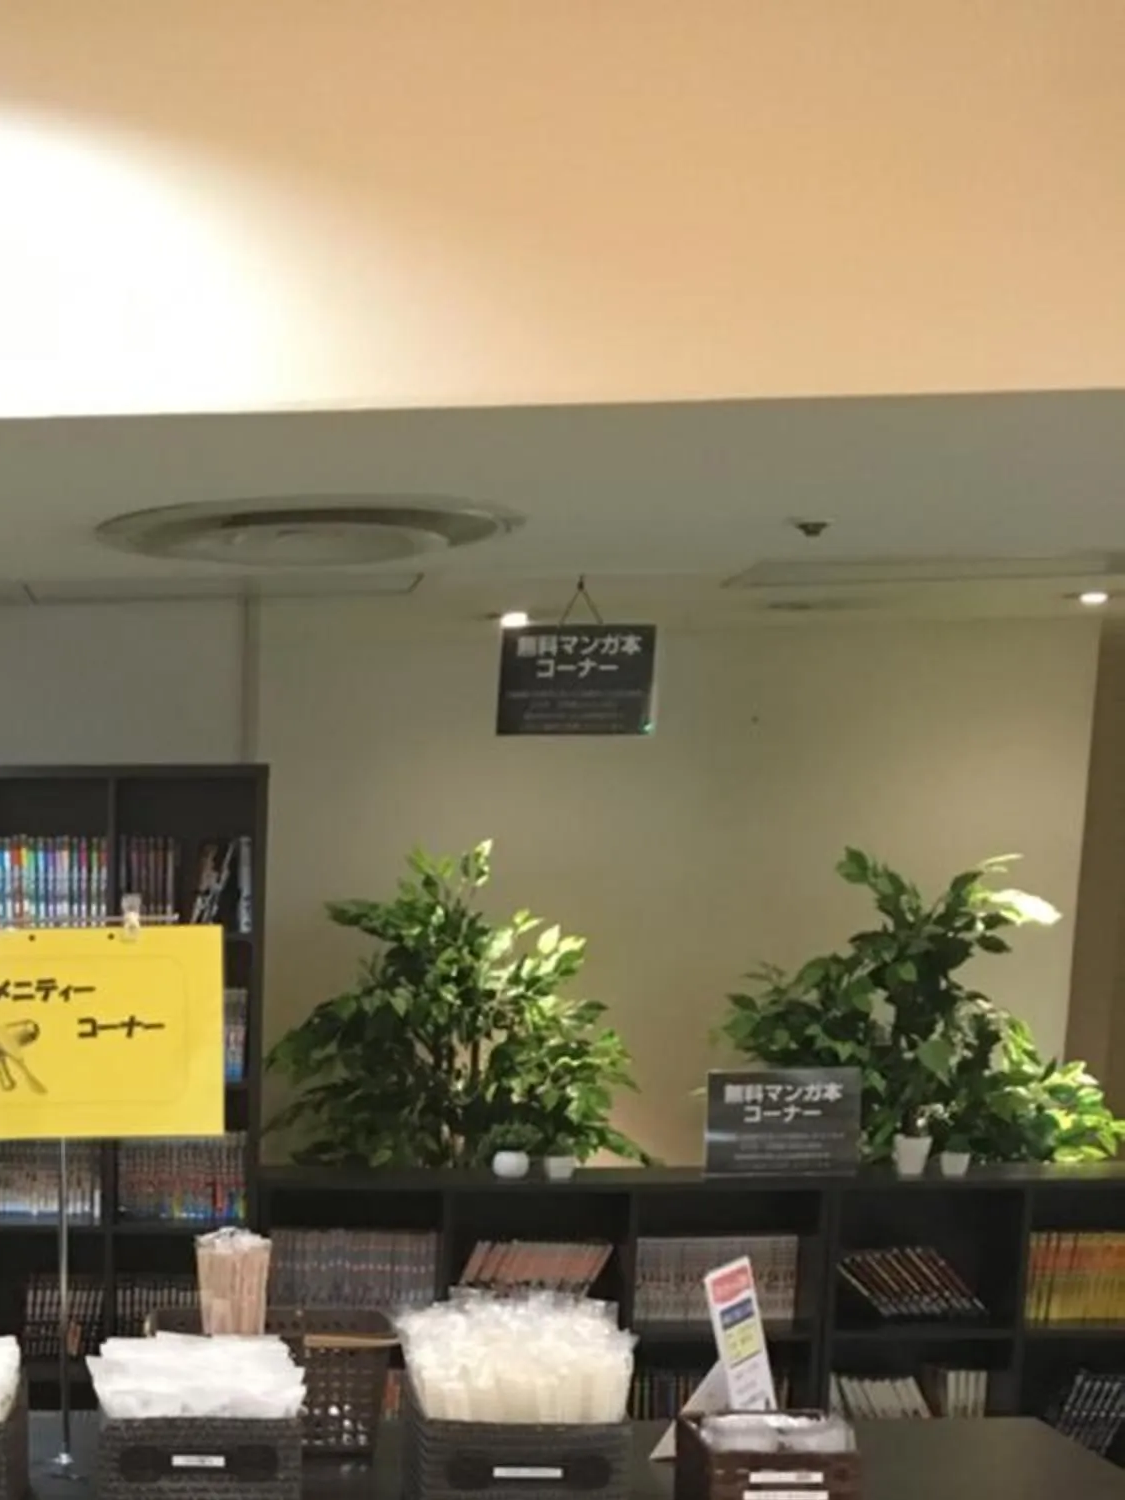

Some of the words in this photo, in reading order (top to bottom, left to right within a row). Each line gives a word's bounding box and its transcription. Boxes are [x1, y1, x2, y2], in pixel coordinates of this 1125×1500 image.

[535, 659, 619, 679] コーナー
[76, 1014, 166, 1040] コーナー
[743, 1105, 822, 1124] コーナー
